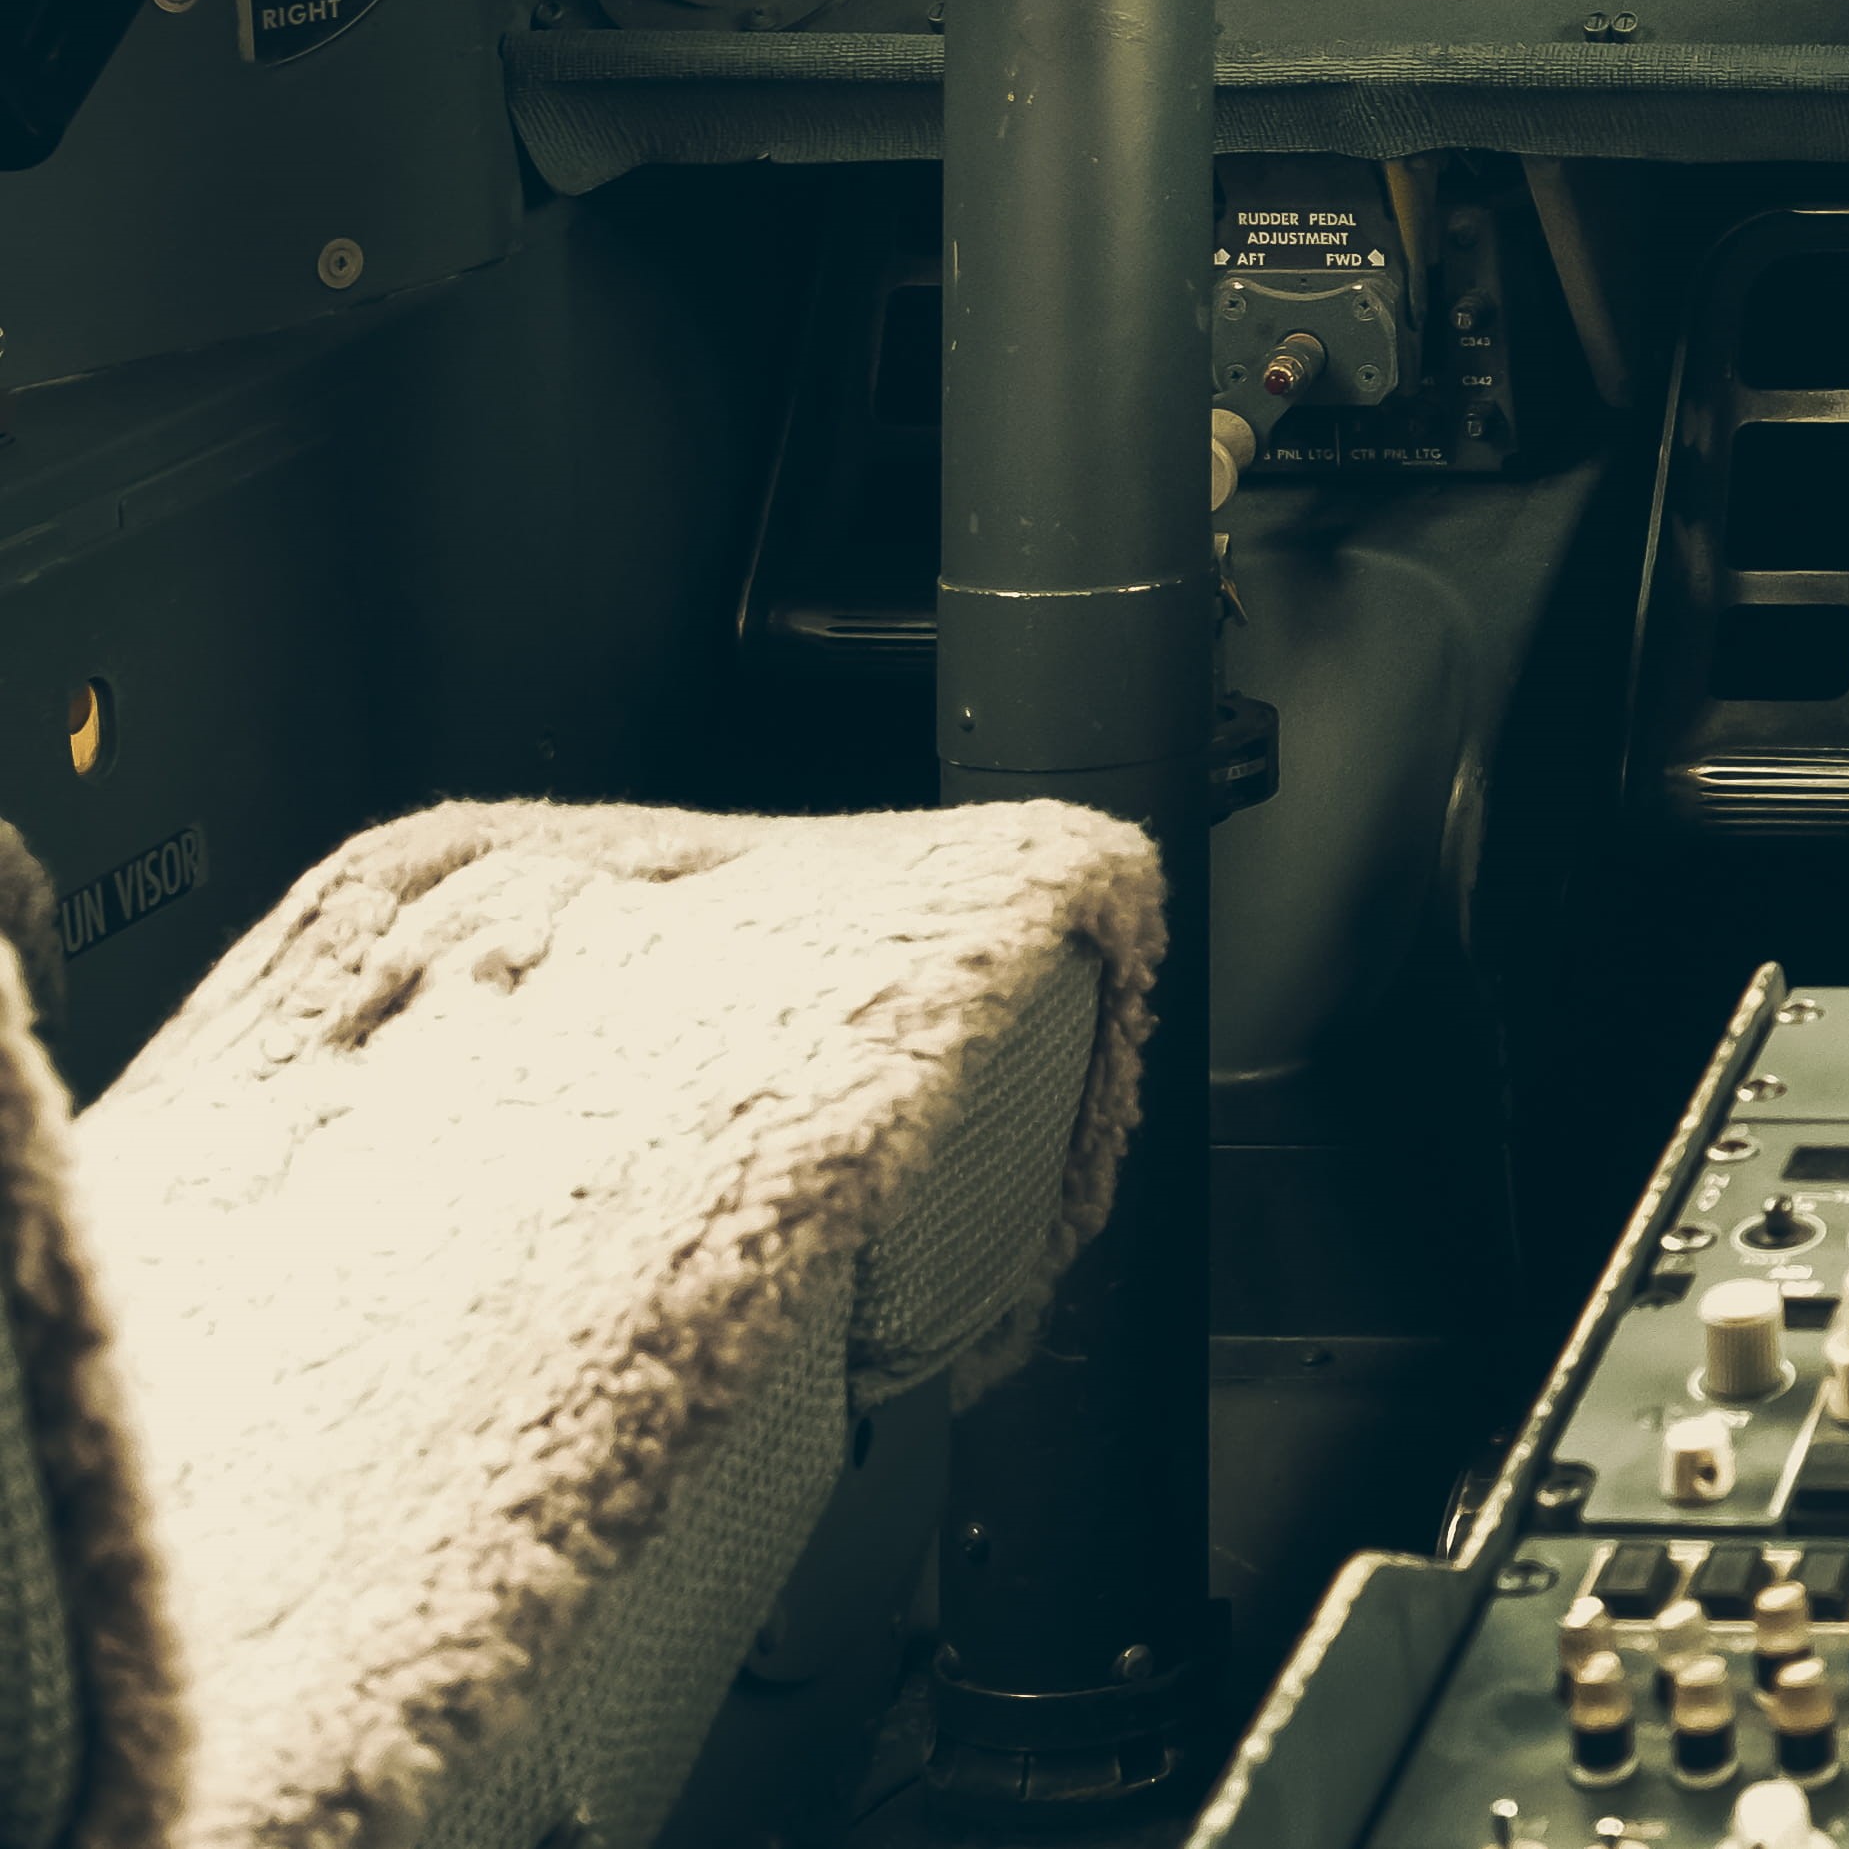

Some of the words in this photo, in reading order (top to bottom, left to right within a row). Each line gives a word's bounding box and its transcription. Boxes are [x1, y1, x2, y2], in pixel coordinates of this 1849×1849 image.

[1238, 212, 1300, 226] RUDDER
[1310, 212, 1356, 226] PEDAL
[1247, 231, 1348, 245] ADJUSTMENT
[1237, 253, 1265, 266] AFT
[1326, 253, 1362, 266] FWD
[60, 882, 106, 953] UN
[114, 831, 199, 920] VISOR
